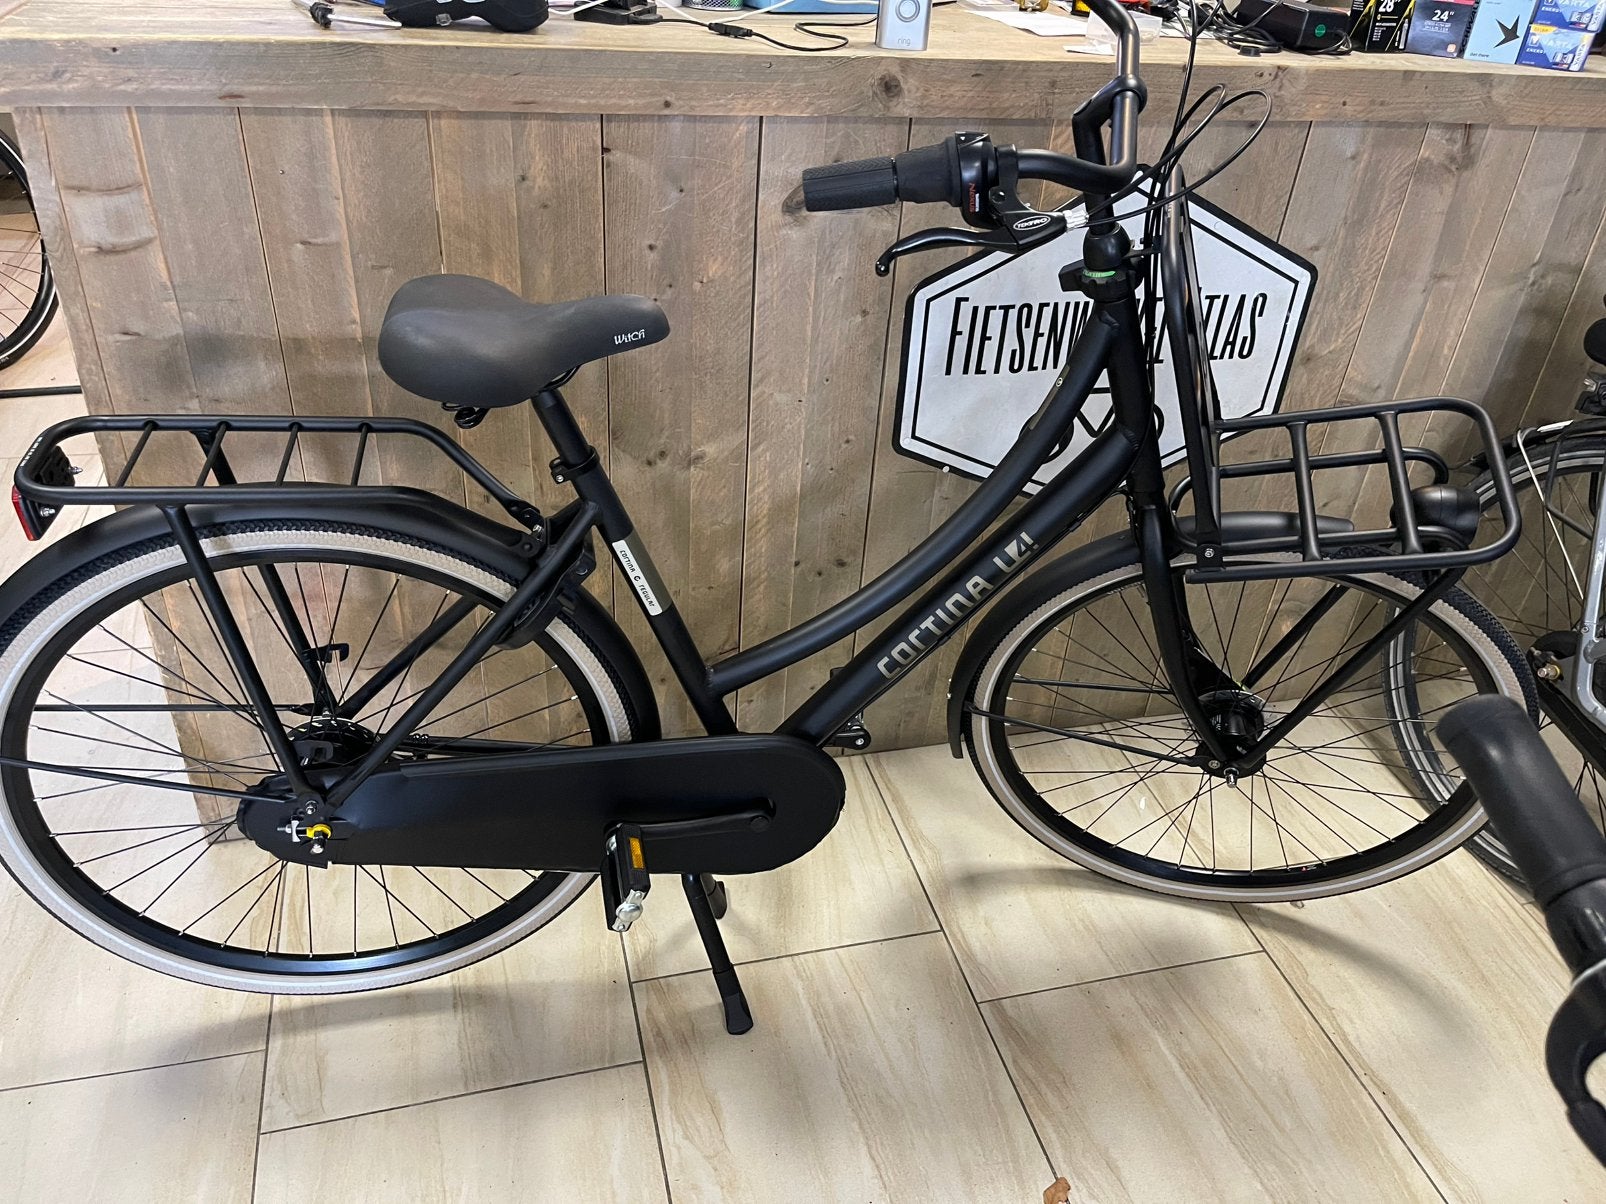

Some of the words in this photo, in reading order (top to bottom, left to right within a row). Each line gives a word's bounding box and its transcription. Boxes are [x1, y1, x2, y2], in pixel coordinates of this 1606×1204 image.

[1432, 9, 1455, 22] 24"
[897, 36, 911, 46] ring
[1199, 288, 1267, 360] TLAS
